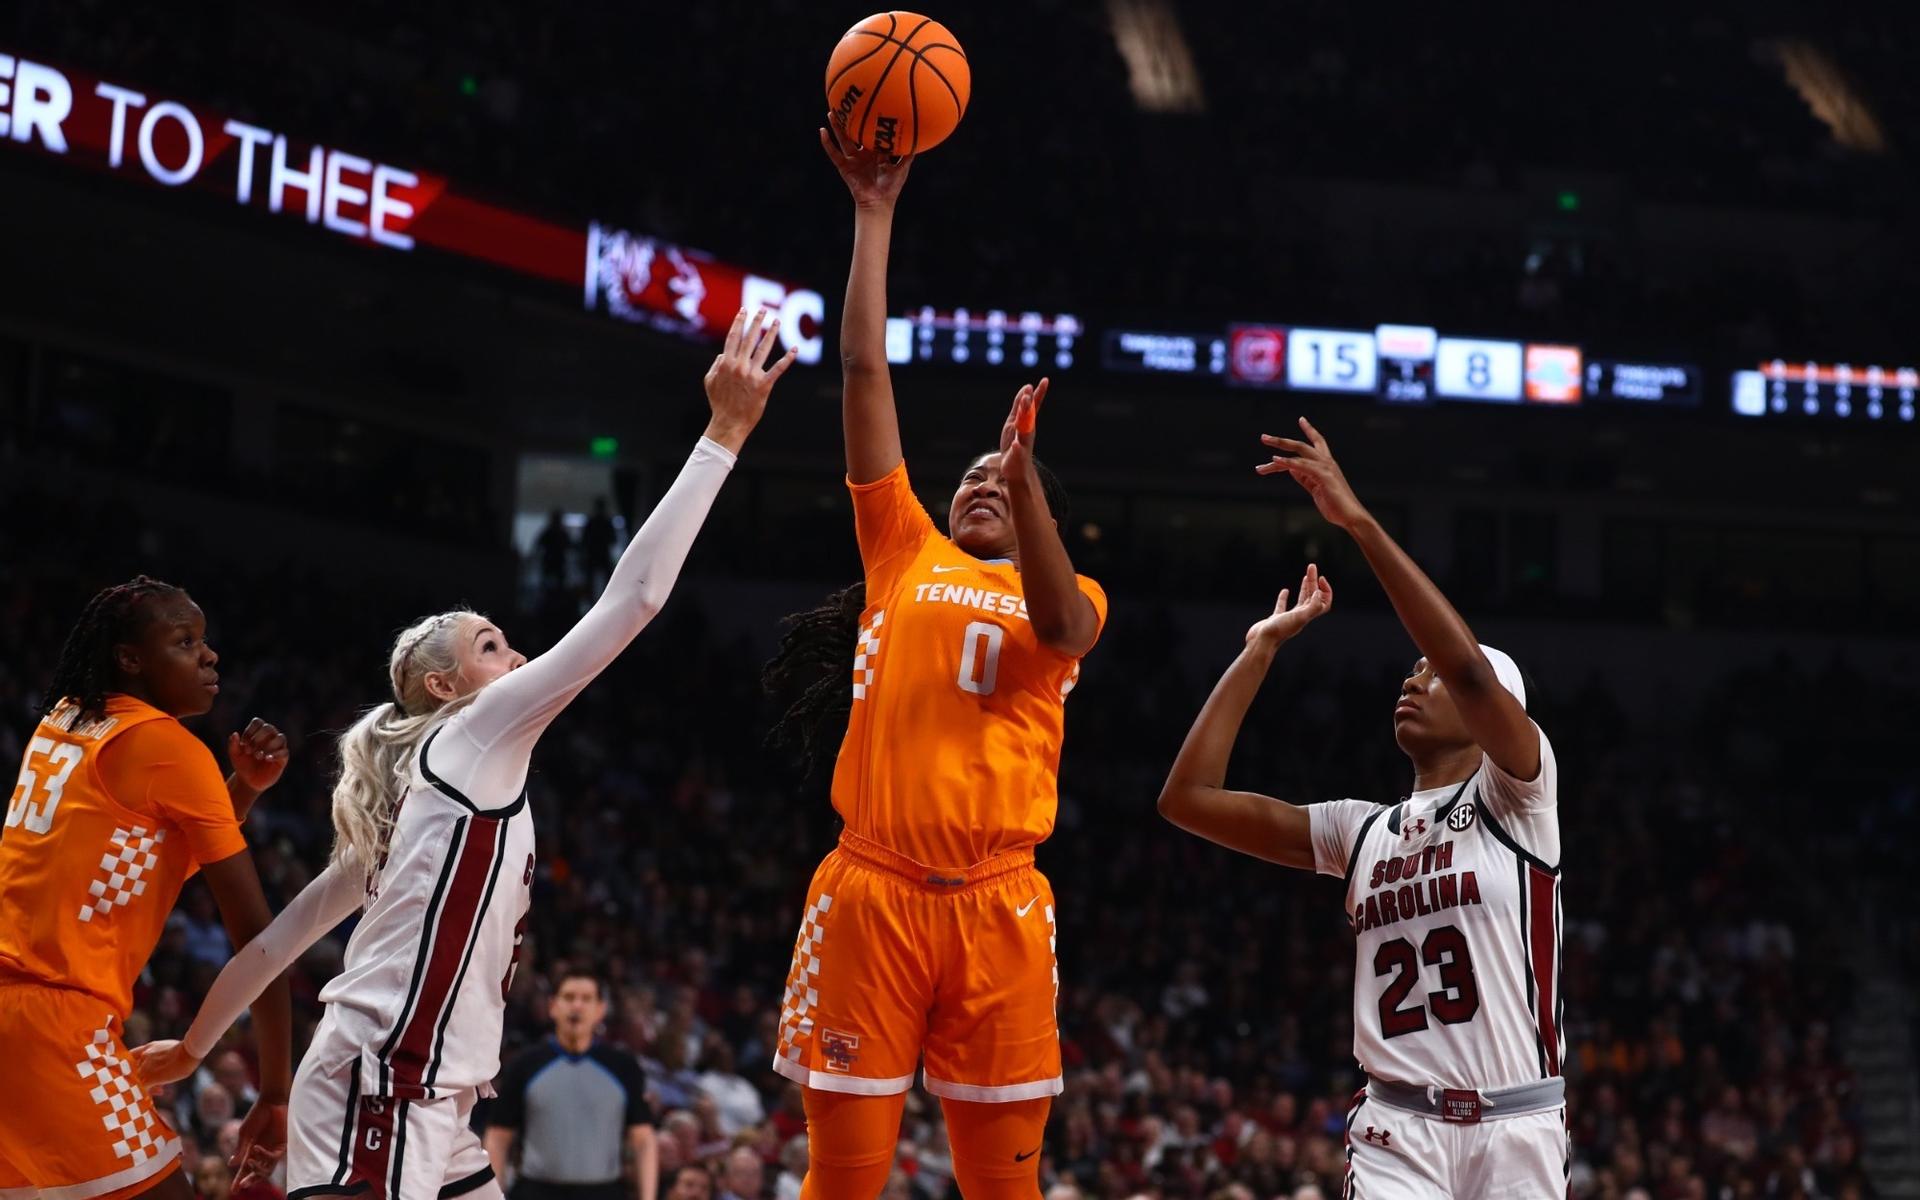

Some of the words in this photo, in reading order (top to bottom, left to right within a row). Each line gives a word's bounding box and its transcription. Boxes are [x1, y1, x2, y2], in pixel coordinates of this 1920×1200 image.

[95, 82, 204, 185] TO
[224, 119, 419, 250] THEE
[1310, 342, 1358, 381] 15
[1467, 352, 1490, 390] 8
[957, 621, 1004, 696] 0
[4, 736, 84, 835] 53
[1450, 804, 1473, 829] SEC
[1370, 841, 1454, 889] SOUTH
[1355, 871, 1482, 936] CAROLINA
[1373, 924, 1480, 1040] 23
